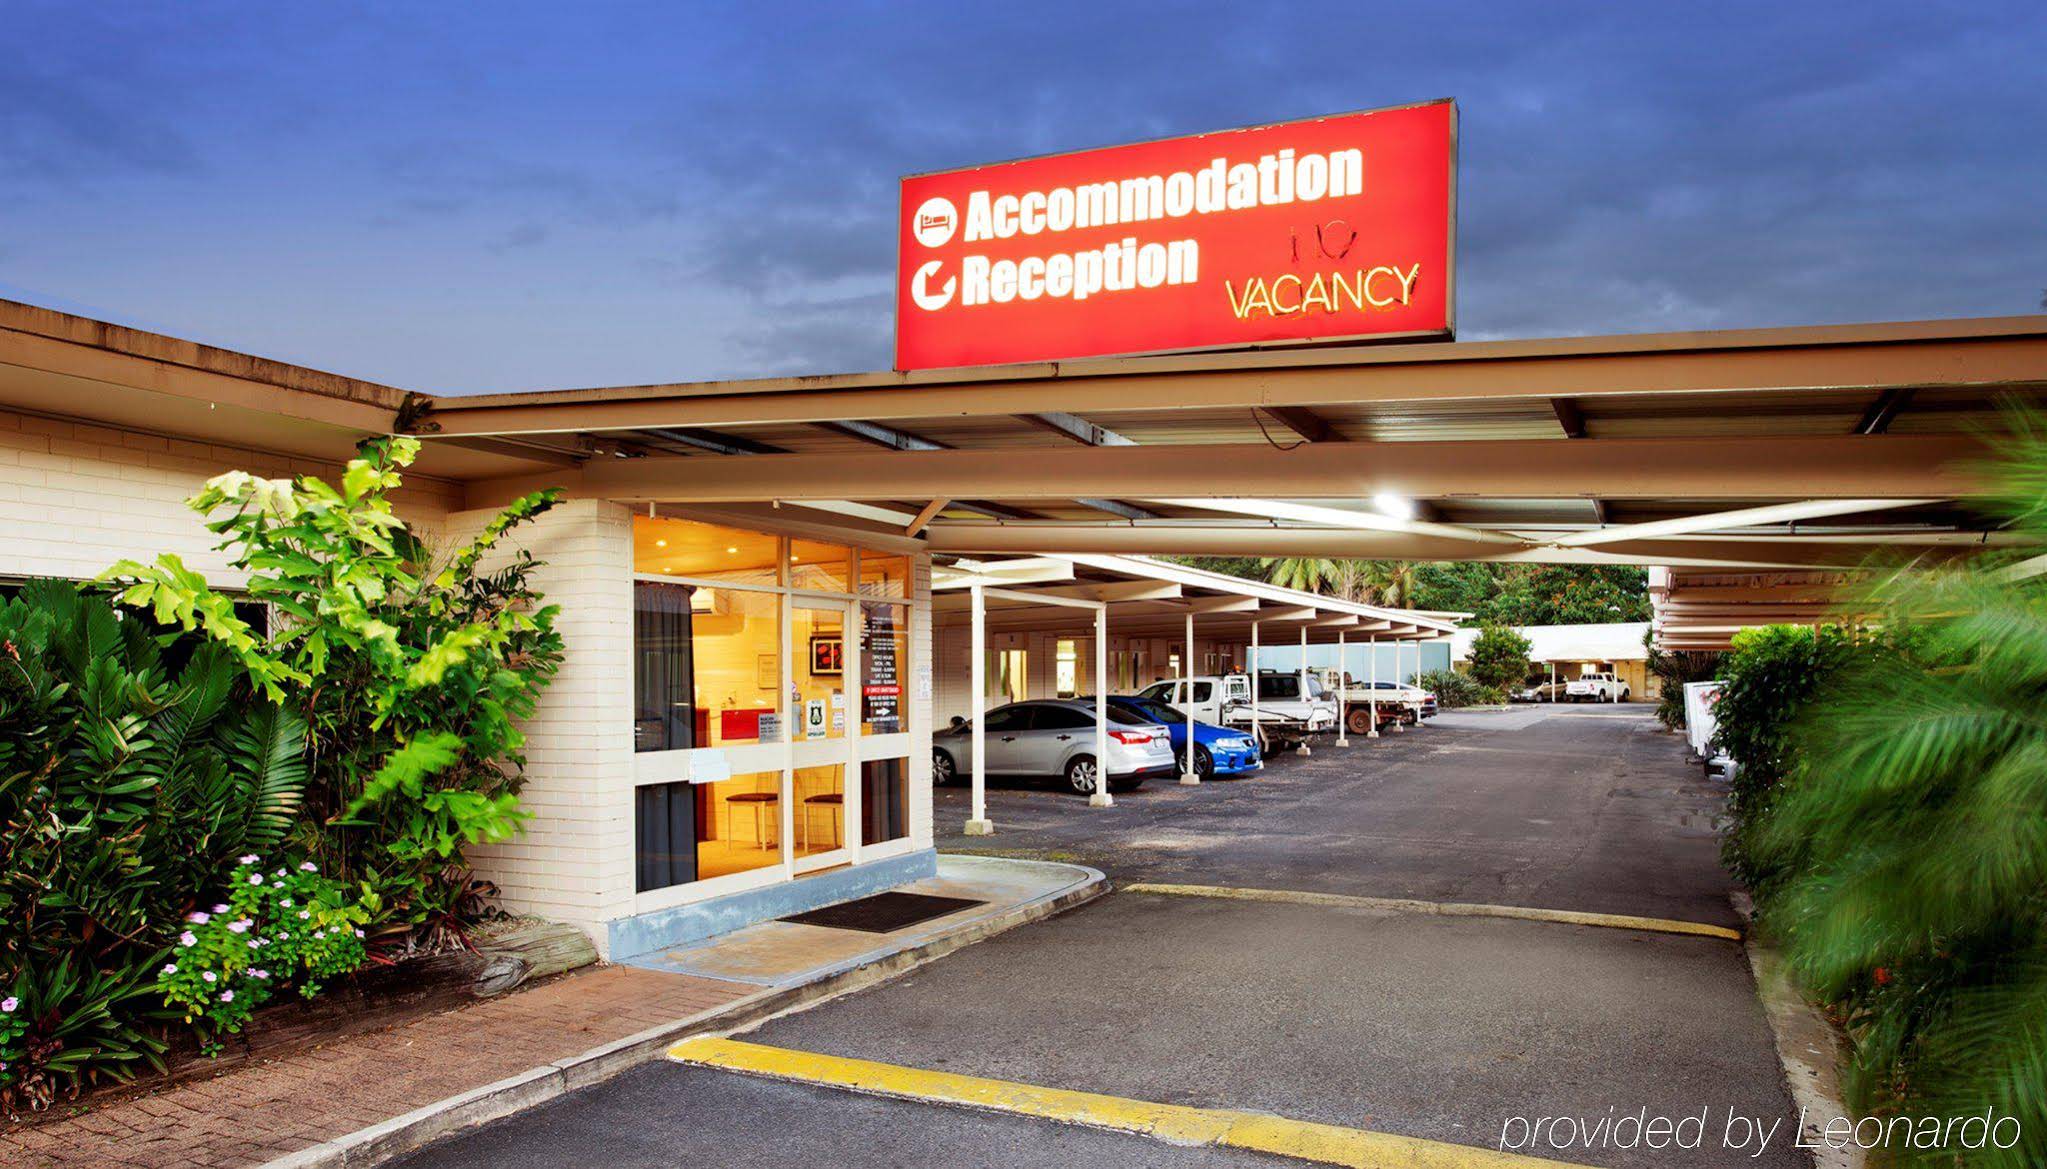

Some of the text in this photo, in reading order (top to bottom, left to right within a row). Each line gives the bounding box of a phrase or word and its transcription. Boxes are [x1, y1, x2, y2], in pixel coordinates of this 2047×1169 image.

[964, 147, 1363, 242] Accommodation
[961, 236, 1199, 306] Reception
[1225, 263, 1420, 319] VACANCY
